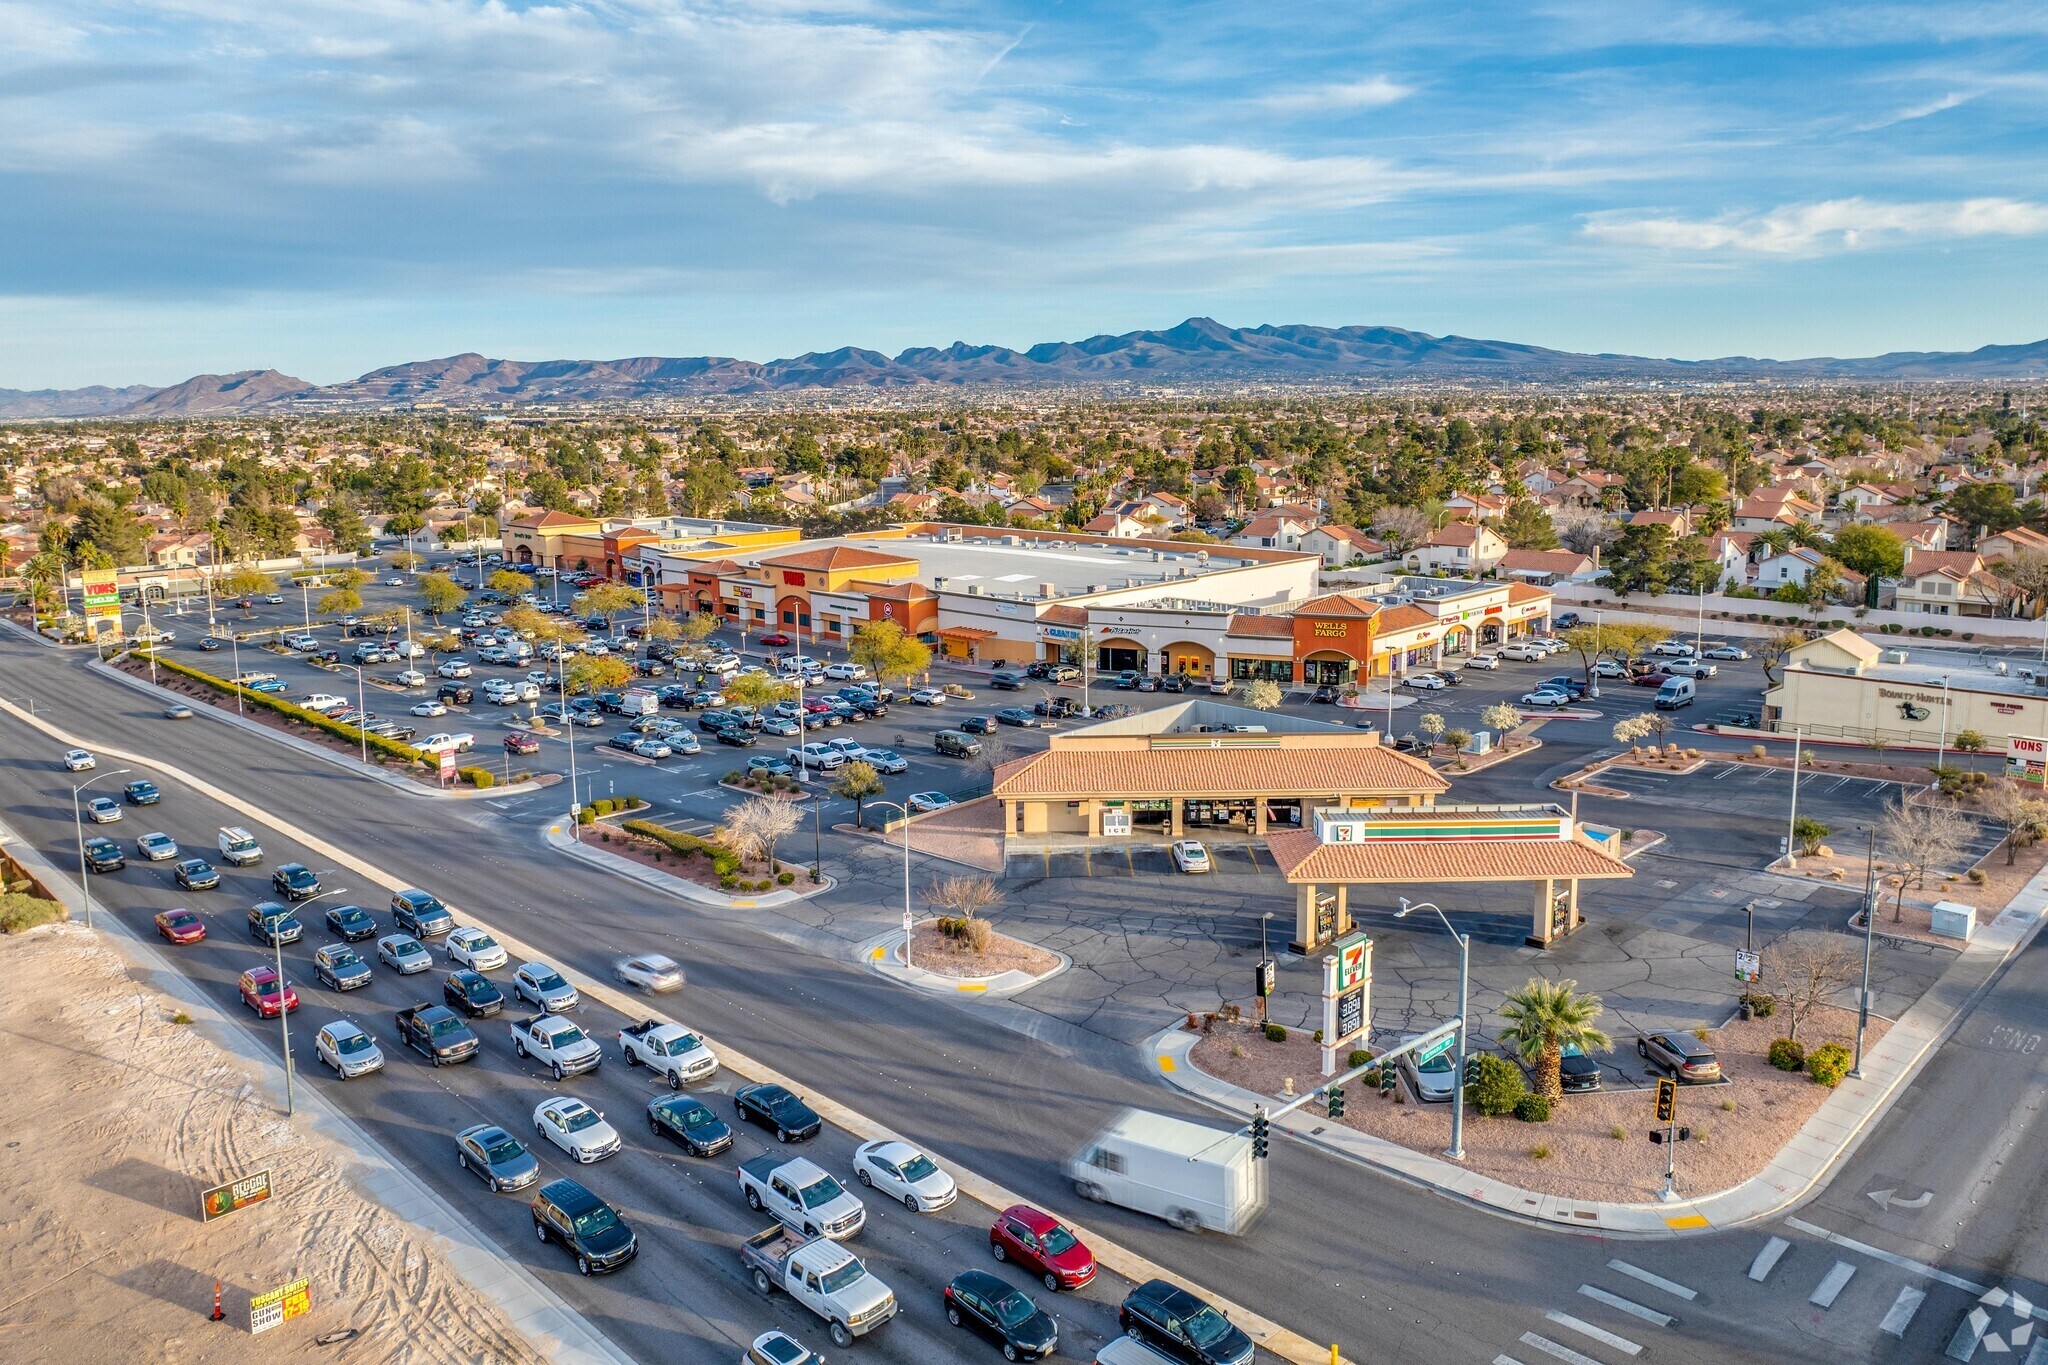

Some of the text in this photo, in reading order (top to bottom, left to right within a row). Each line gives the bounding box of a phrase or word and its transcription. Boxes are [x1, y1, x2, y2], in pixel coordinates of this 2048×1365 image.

[783, 571, 805, 587] VONS
[85, 583, 117, 595] VONS
[1315, 622, 1347, 630] WELLS
[1315, 629, 1346, 637] FARGO
[1879, 688, 1914, 700] BOUNTY
[2013, 739, 2043, 752] VONS
[232, 1173, 268, 1197] REGGAE
[251, 1278, 308, 1307] TUSCANY SUITES
[285, 1292, 307, 1307] FEB
[252, 1307, 271, 1319] GUN
[252, 1311, 281, 1328] SHOW
